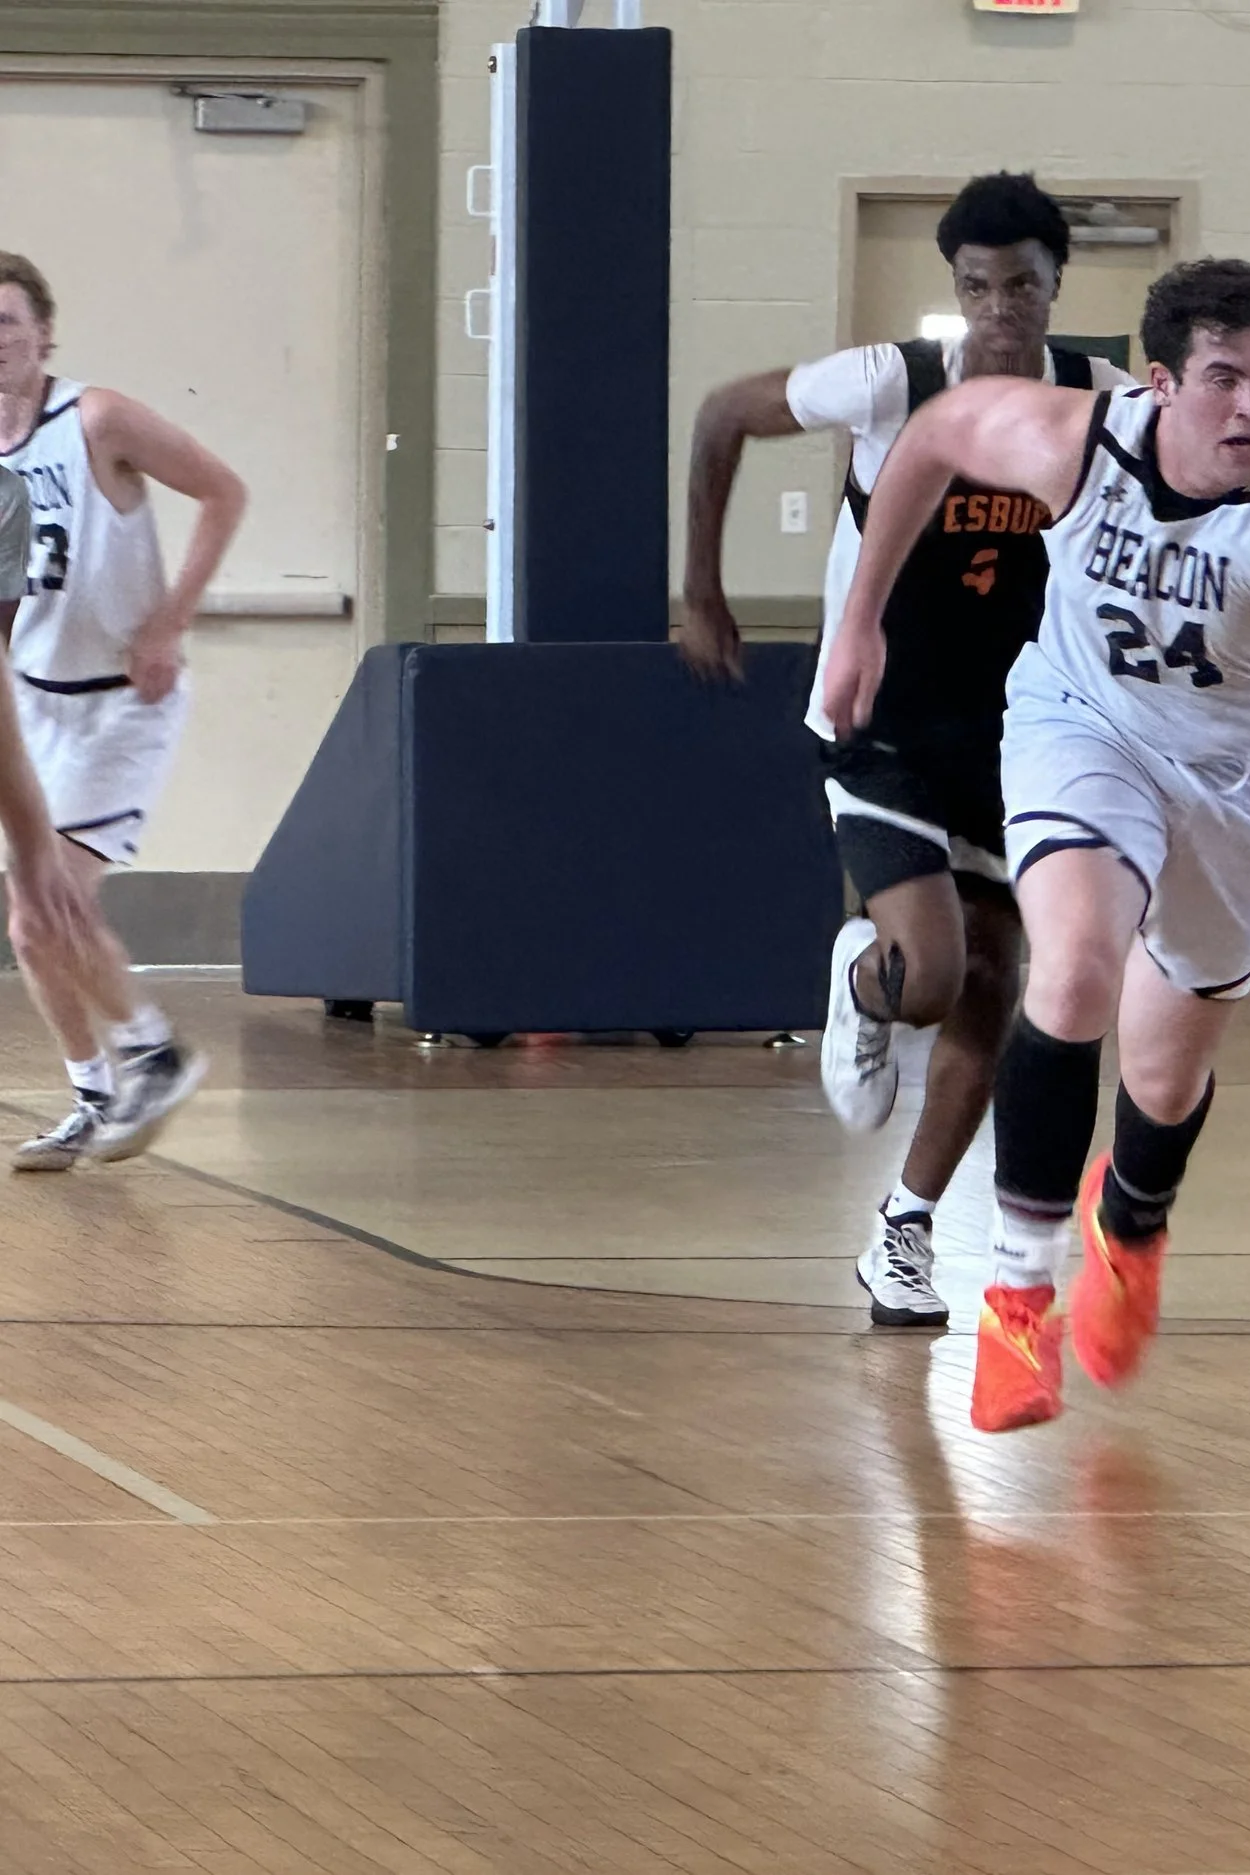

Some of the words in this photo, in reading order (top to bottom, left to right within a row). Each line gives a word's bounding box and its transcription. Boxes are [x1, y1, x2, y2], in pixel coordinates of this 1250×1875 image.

[26, 522, 70, 596] 3
[1085, 519, 1230, 613] BEACON
[1096, 602, 1224, 688] 24
